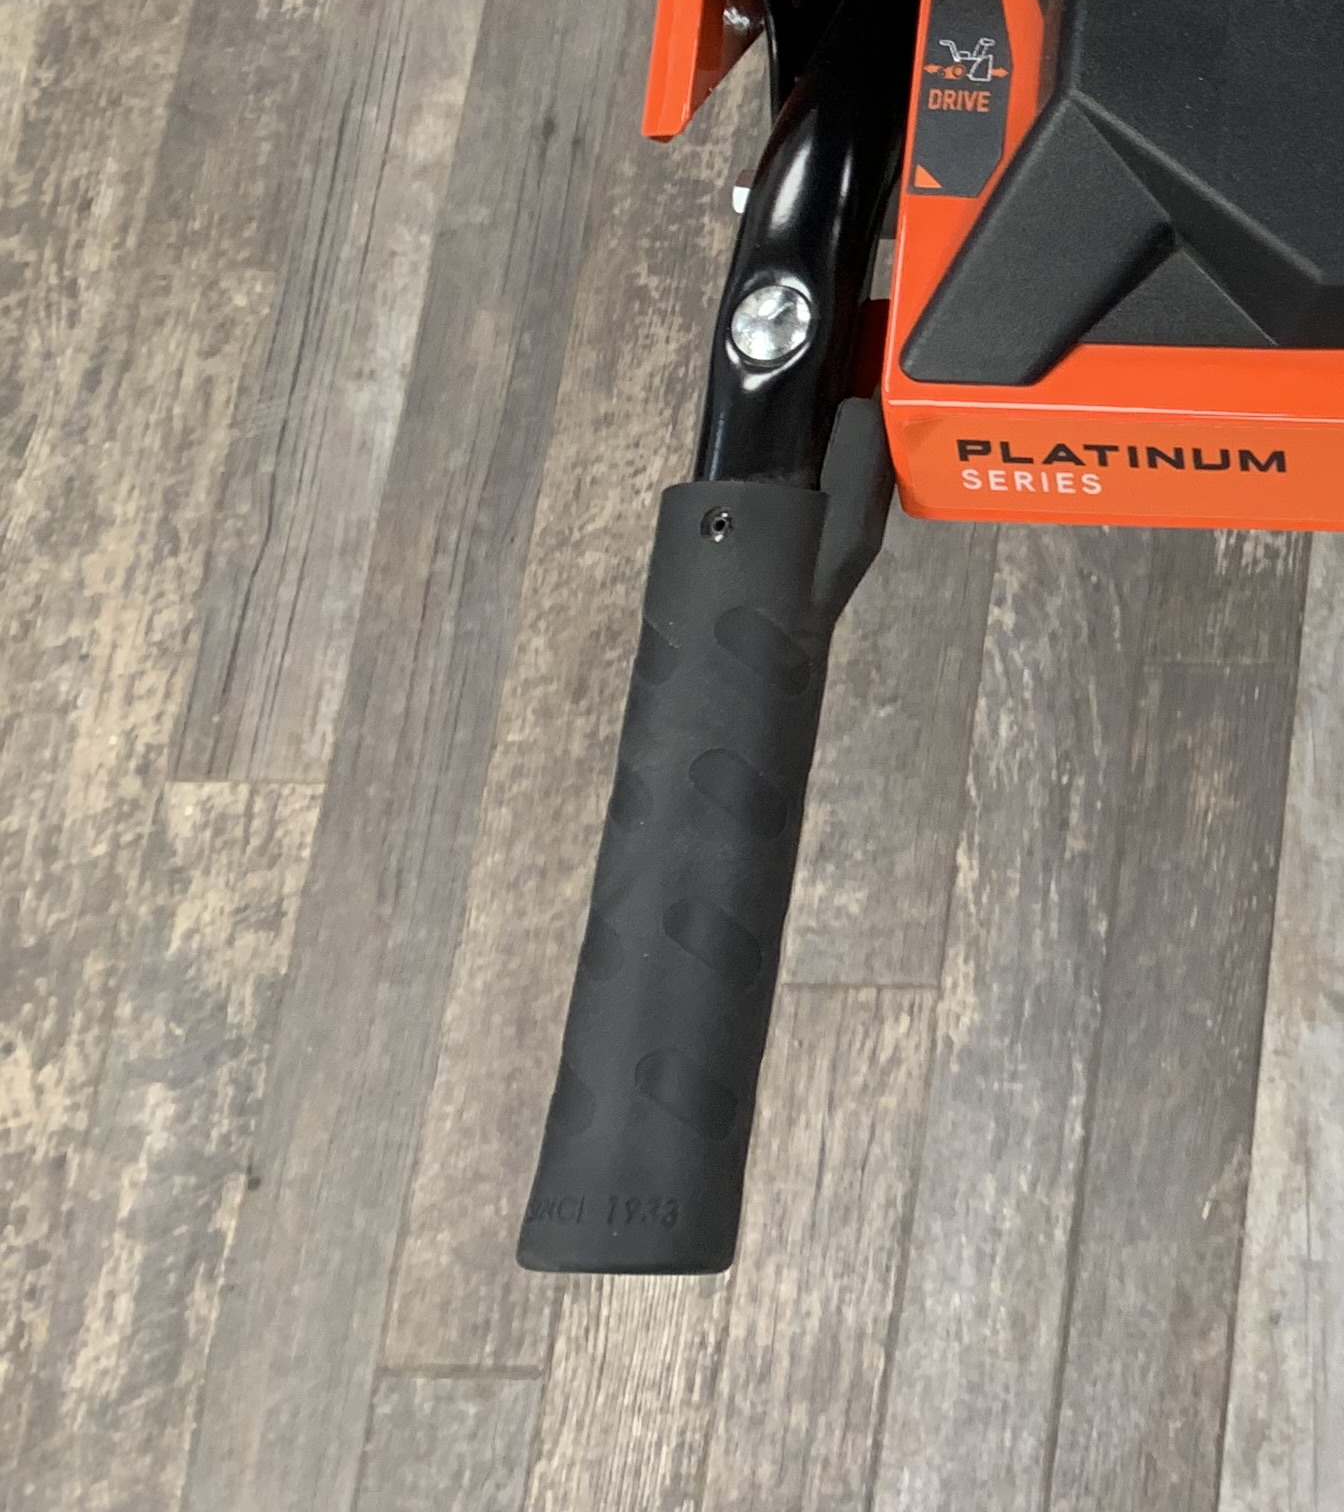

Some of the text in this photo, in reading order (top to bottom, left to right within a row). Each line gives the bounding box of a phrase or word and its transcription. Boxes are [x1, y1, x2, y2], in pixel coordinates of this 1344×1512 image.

[928, 89, 992, 113] DRIVE
[957, 439, 1287, 473] PLATINUM
[961, 469, 1102, 495] SERIES
